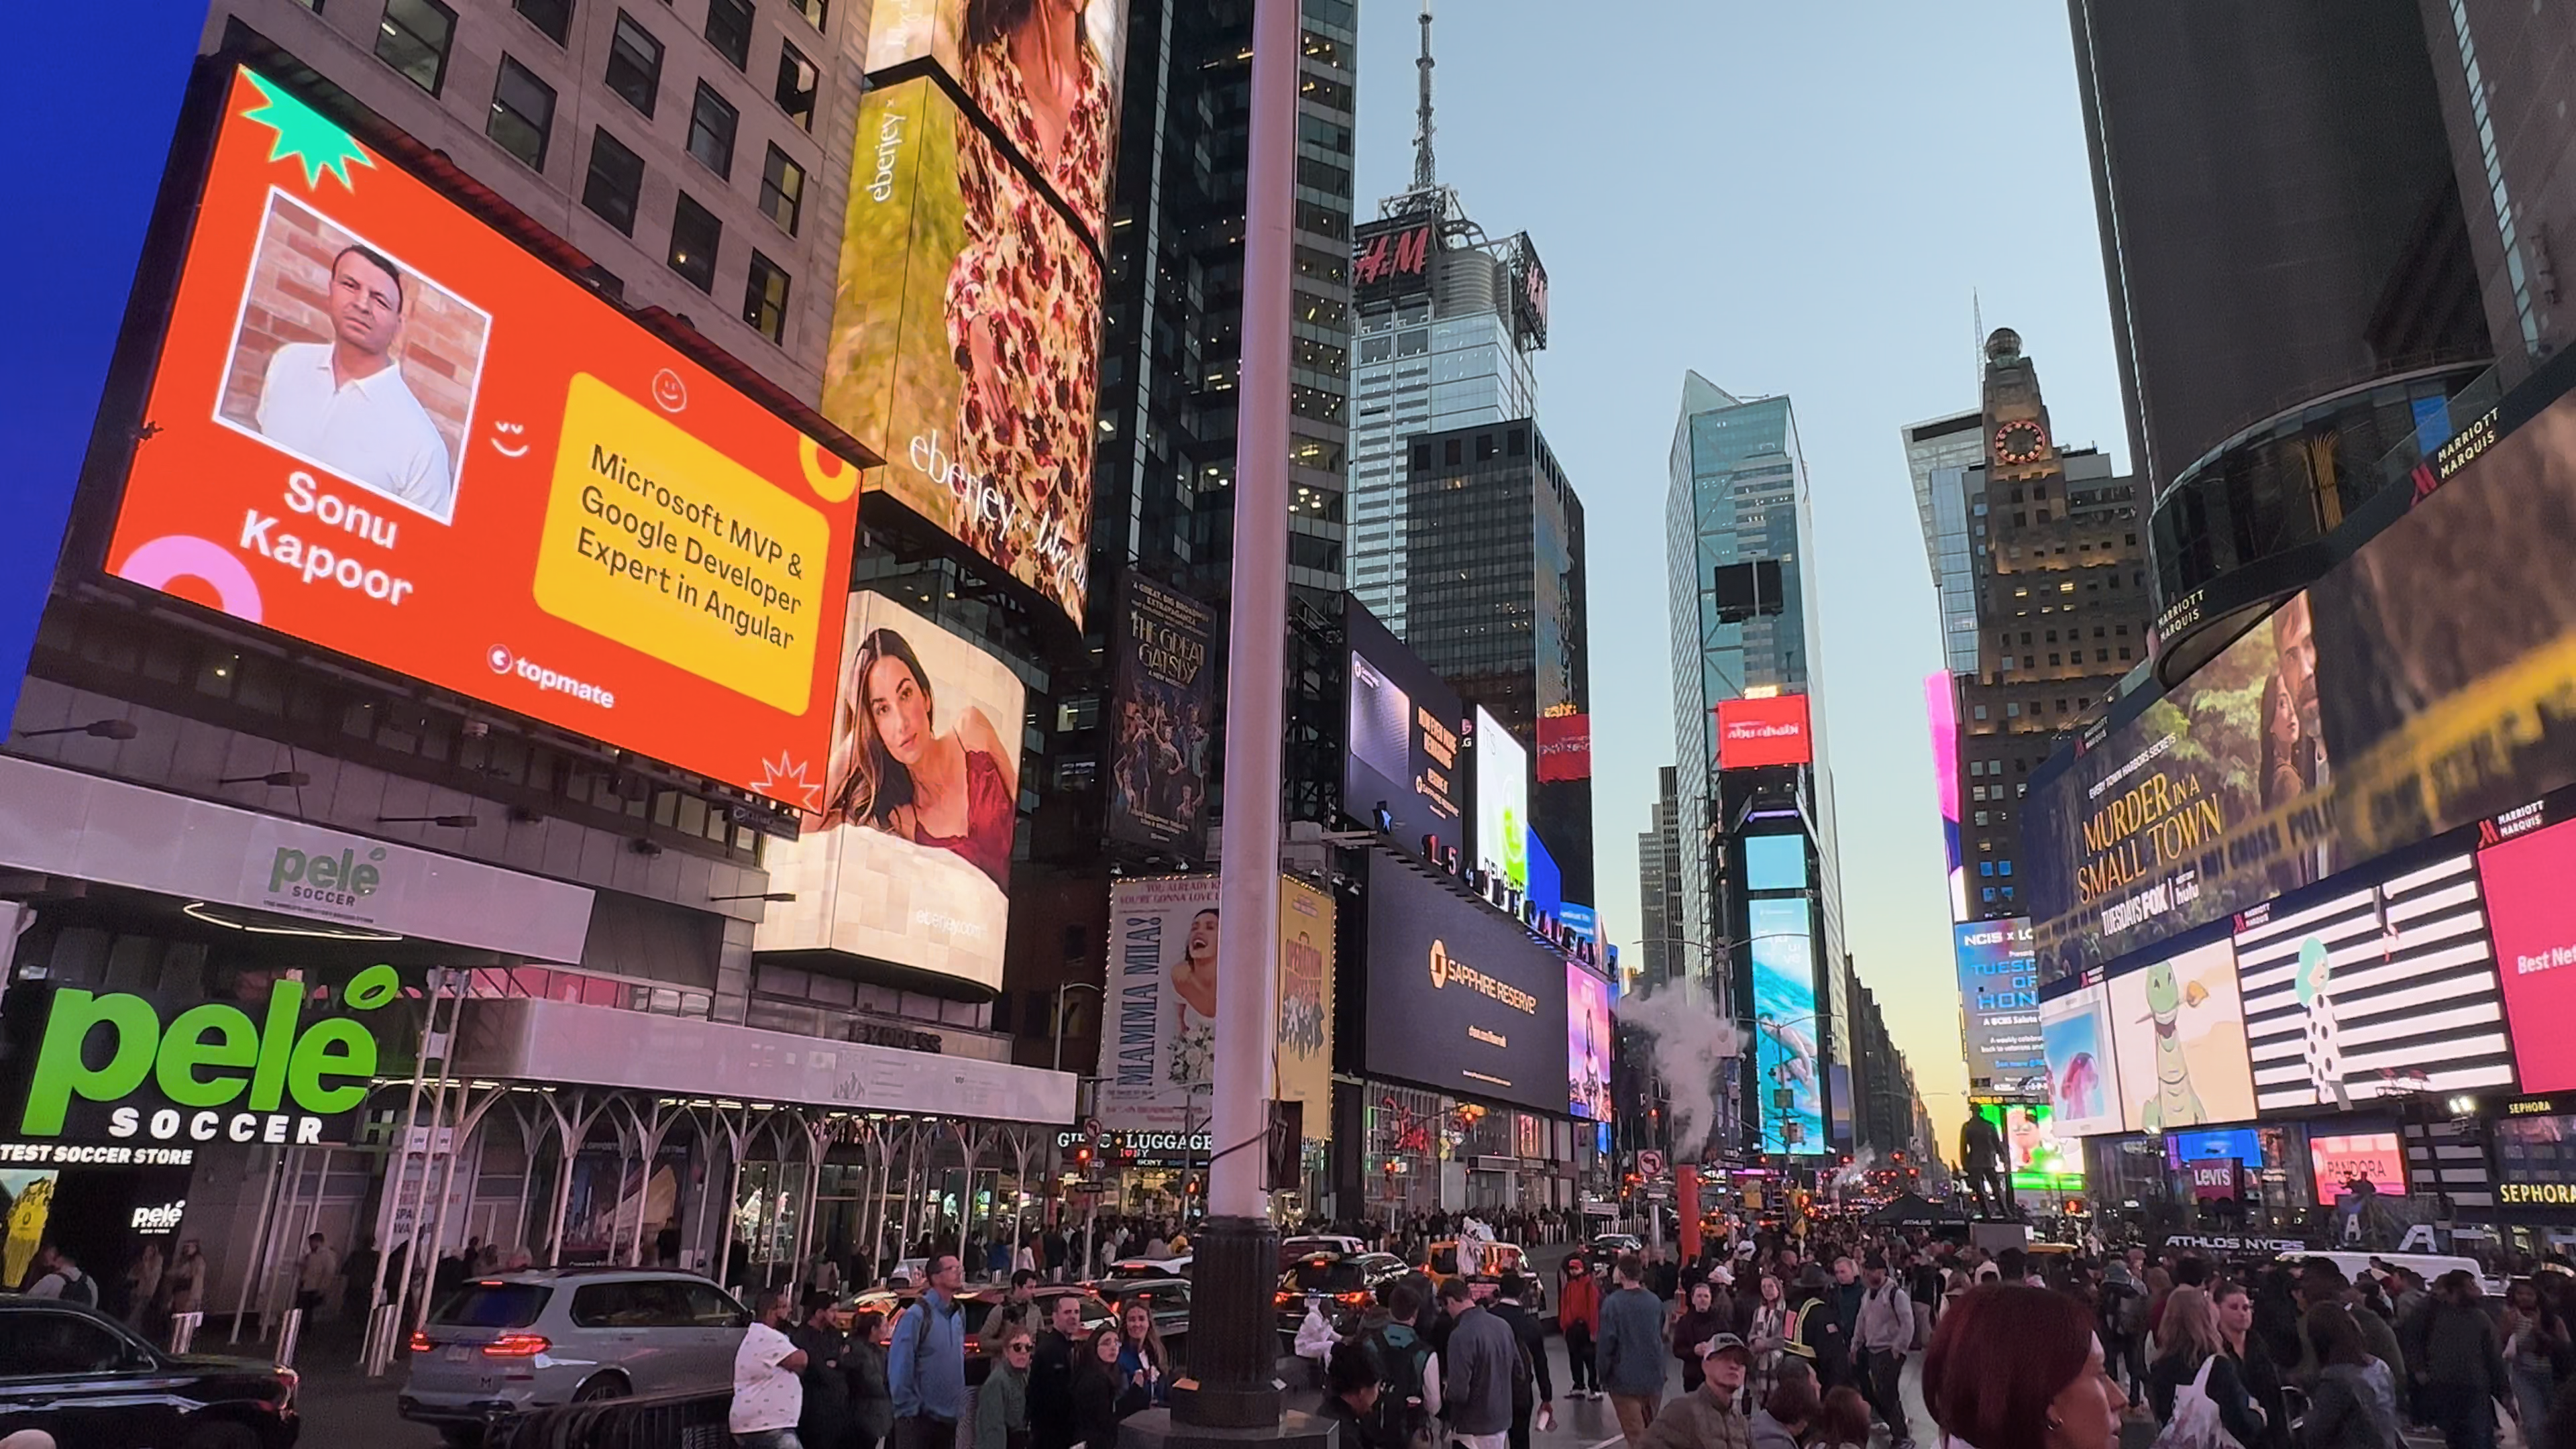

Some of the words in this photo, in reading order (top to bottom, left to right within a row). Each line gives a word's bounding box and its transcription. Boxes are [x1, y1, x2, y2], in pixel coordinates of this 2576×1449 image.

[866, 113, 906, 201] eberjey
[1353, 227, 1429, 284] H&M
[2438, 407, 2498, 463] MARRIOTT
[2440, 430, 2495, 479] MARQUIS
[910, 429, 1016, 541] eberjey
[284, 470, 398, 550] Sonu
[590, 444, 722, 537] Microsoft
[729, 521, 782, 564] MVP
[787, 553, 803, 580] &
[239, 508, 413, 606] Kapoor
[582, 484, 678, 554] Google
[685, 537, 802, 614] Developer
[578, 527, 671, 594] Expert
[677, 574, 698, 608] in
[704, 590, 794, 649] Angular
[2157, 589, 2204, 629] MARRIOTT
[1160, 628, 1204, 666] GREAT
[2160, 608, 2200, 643] MARQUIS
[516, 655, 614, 709] topmate
[1138, 643, 1197, 684] GATSBY
[2089, 781, 2106, 800] EVERY
[2106, 769, 2123, 788] TOWN
[2122, 751, 2149, 777] HARBORS
[2149, 733, 2176, 759] SECRETS
[2082, 772, 2172, 857] MURDER
[2173, 779, 2188, 805] IN
[2190, 773, 2201, 794] A
[2498, 800, 2544, 825] MARRIOTT
[2500, 813, 2542, 837] MARQUIS
[269, 847, 386, 896] pelé
[2078, 839, 2146, 904] SMALL
[2147, 793, 2222, 867] TOWN
[292, 885, 356, 906] SOCCER
[1153, 894, 1186, 903] GONNA
[2101, 895, 2142, 937] TUESDAYS
[2142, 883, 2168, 919] FOX
[2176, 881, 2200, 905] hulu
[1964, 932, 2003, 947] NCIS
[2517, 951, 2549, 975] Best
[1448, 959, 1496, 999] SAPPHIRE
[1496, 980, 1537, 1015] RESERVE
[20, 964, 399, 1136] pelé
[1117, 982, 1159, 1086] MAMMA
[109, 1107, 323, 1144] SOCCER
[2508, 1100, 2551, 1115] SEPHORA
[0, 1144, 52, 1162] TEST
[52, 1146, 131, 1164] SOCCER
[133, 1148, 193, 1165] STORE
[2327, 1159, 2386, 1177] PANDORA
[131, 1199, 186, 1228] pelé
[2165, 1235, 2241, 1249] ATHLOS
